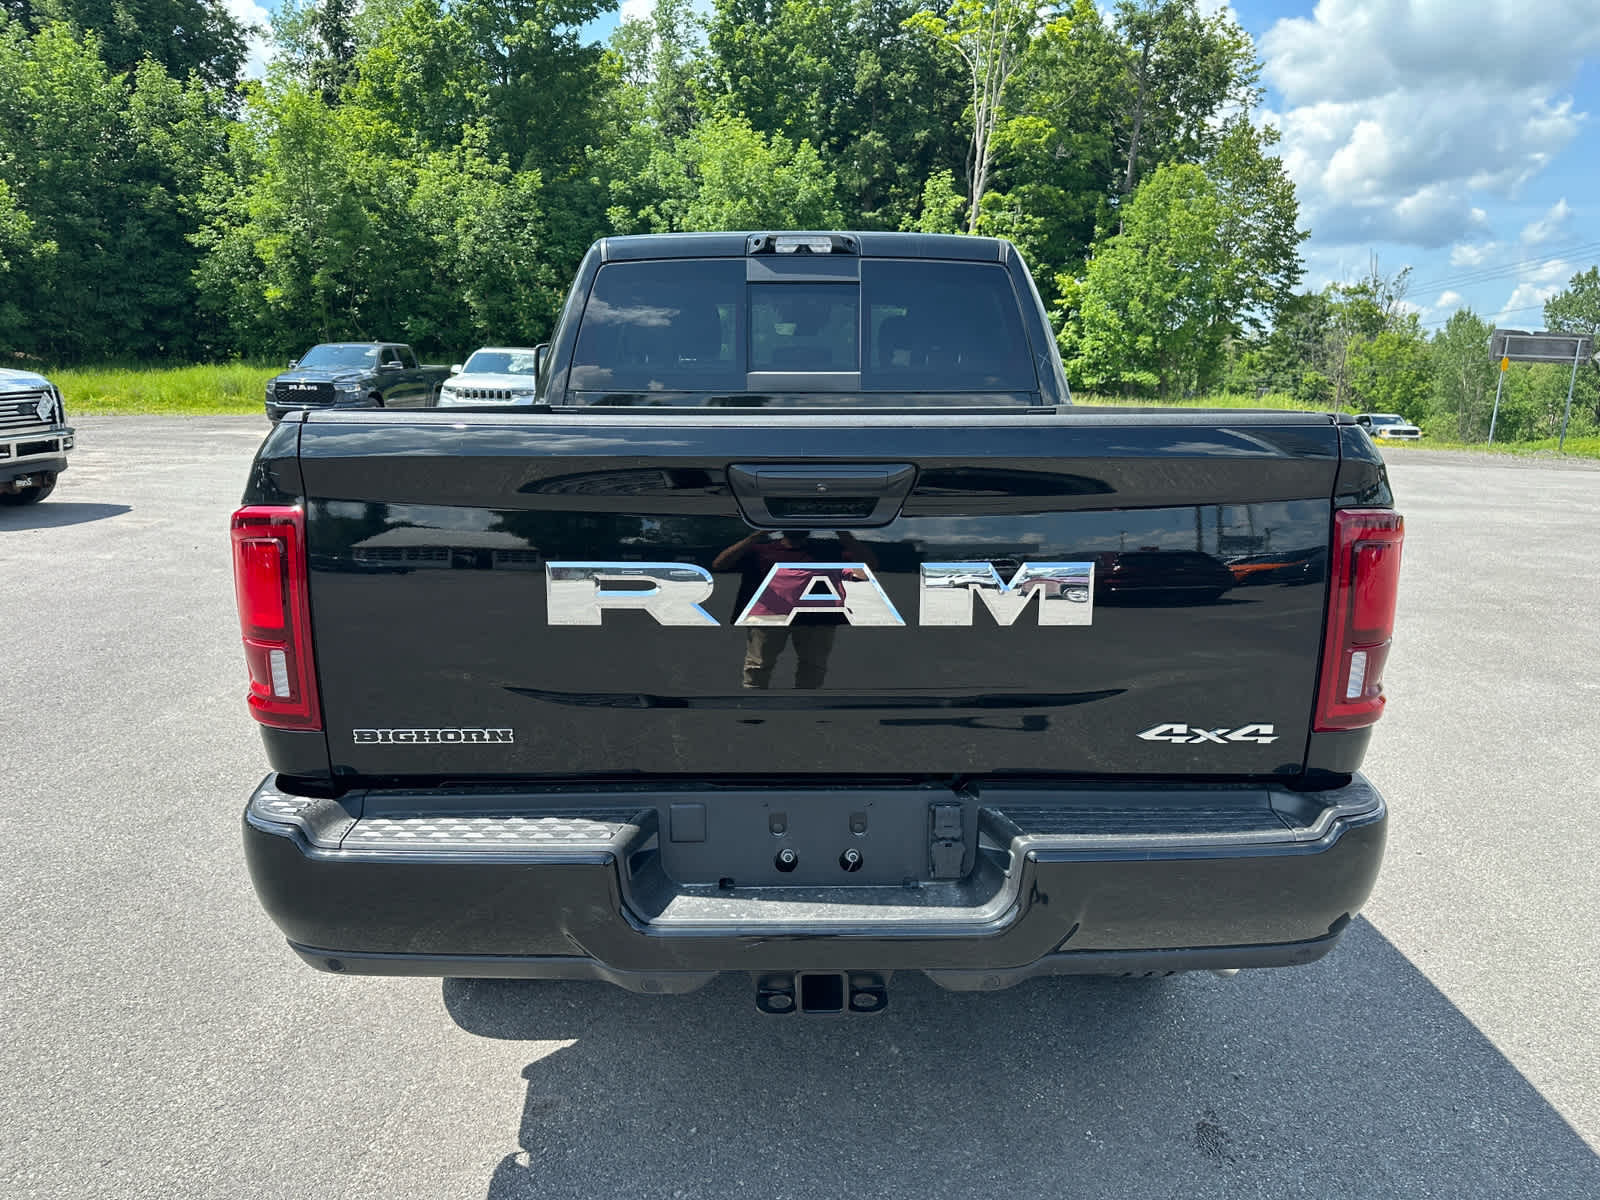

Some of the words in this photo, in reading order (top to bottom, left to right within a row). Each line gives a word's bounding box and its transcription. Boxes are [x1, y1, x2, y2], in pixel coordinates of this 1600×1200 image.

[545, 561, 1096, 627] RAM
[352, 728, 515, 744] BIGHORN
[1135, 723, 1280, 744] 4x4
